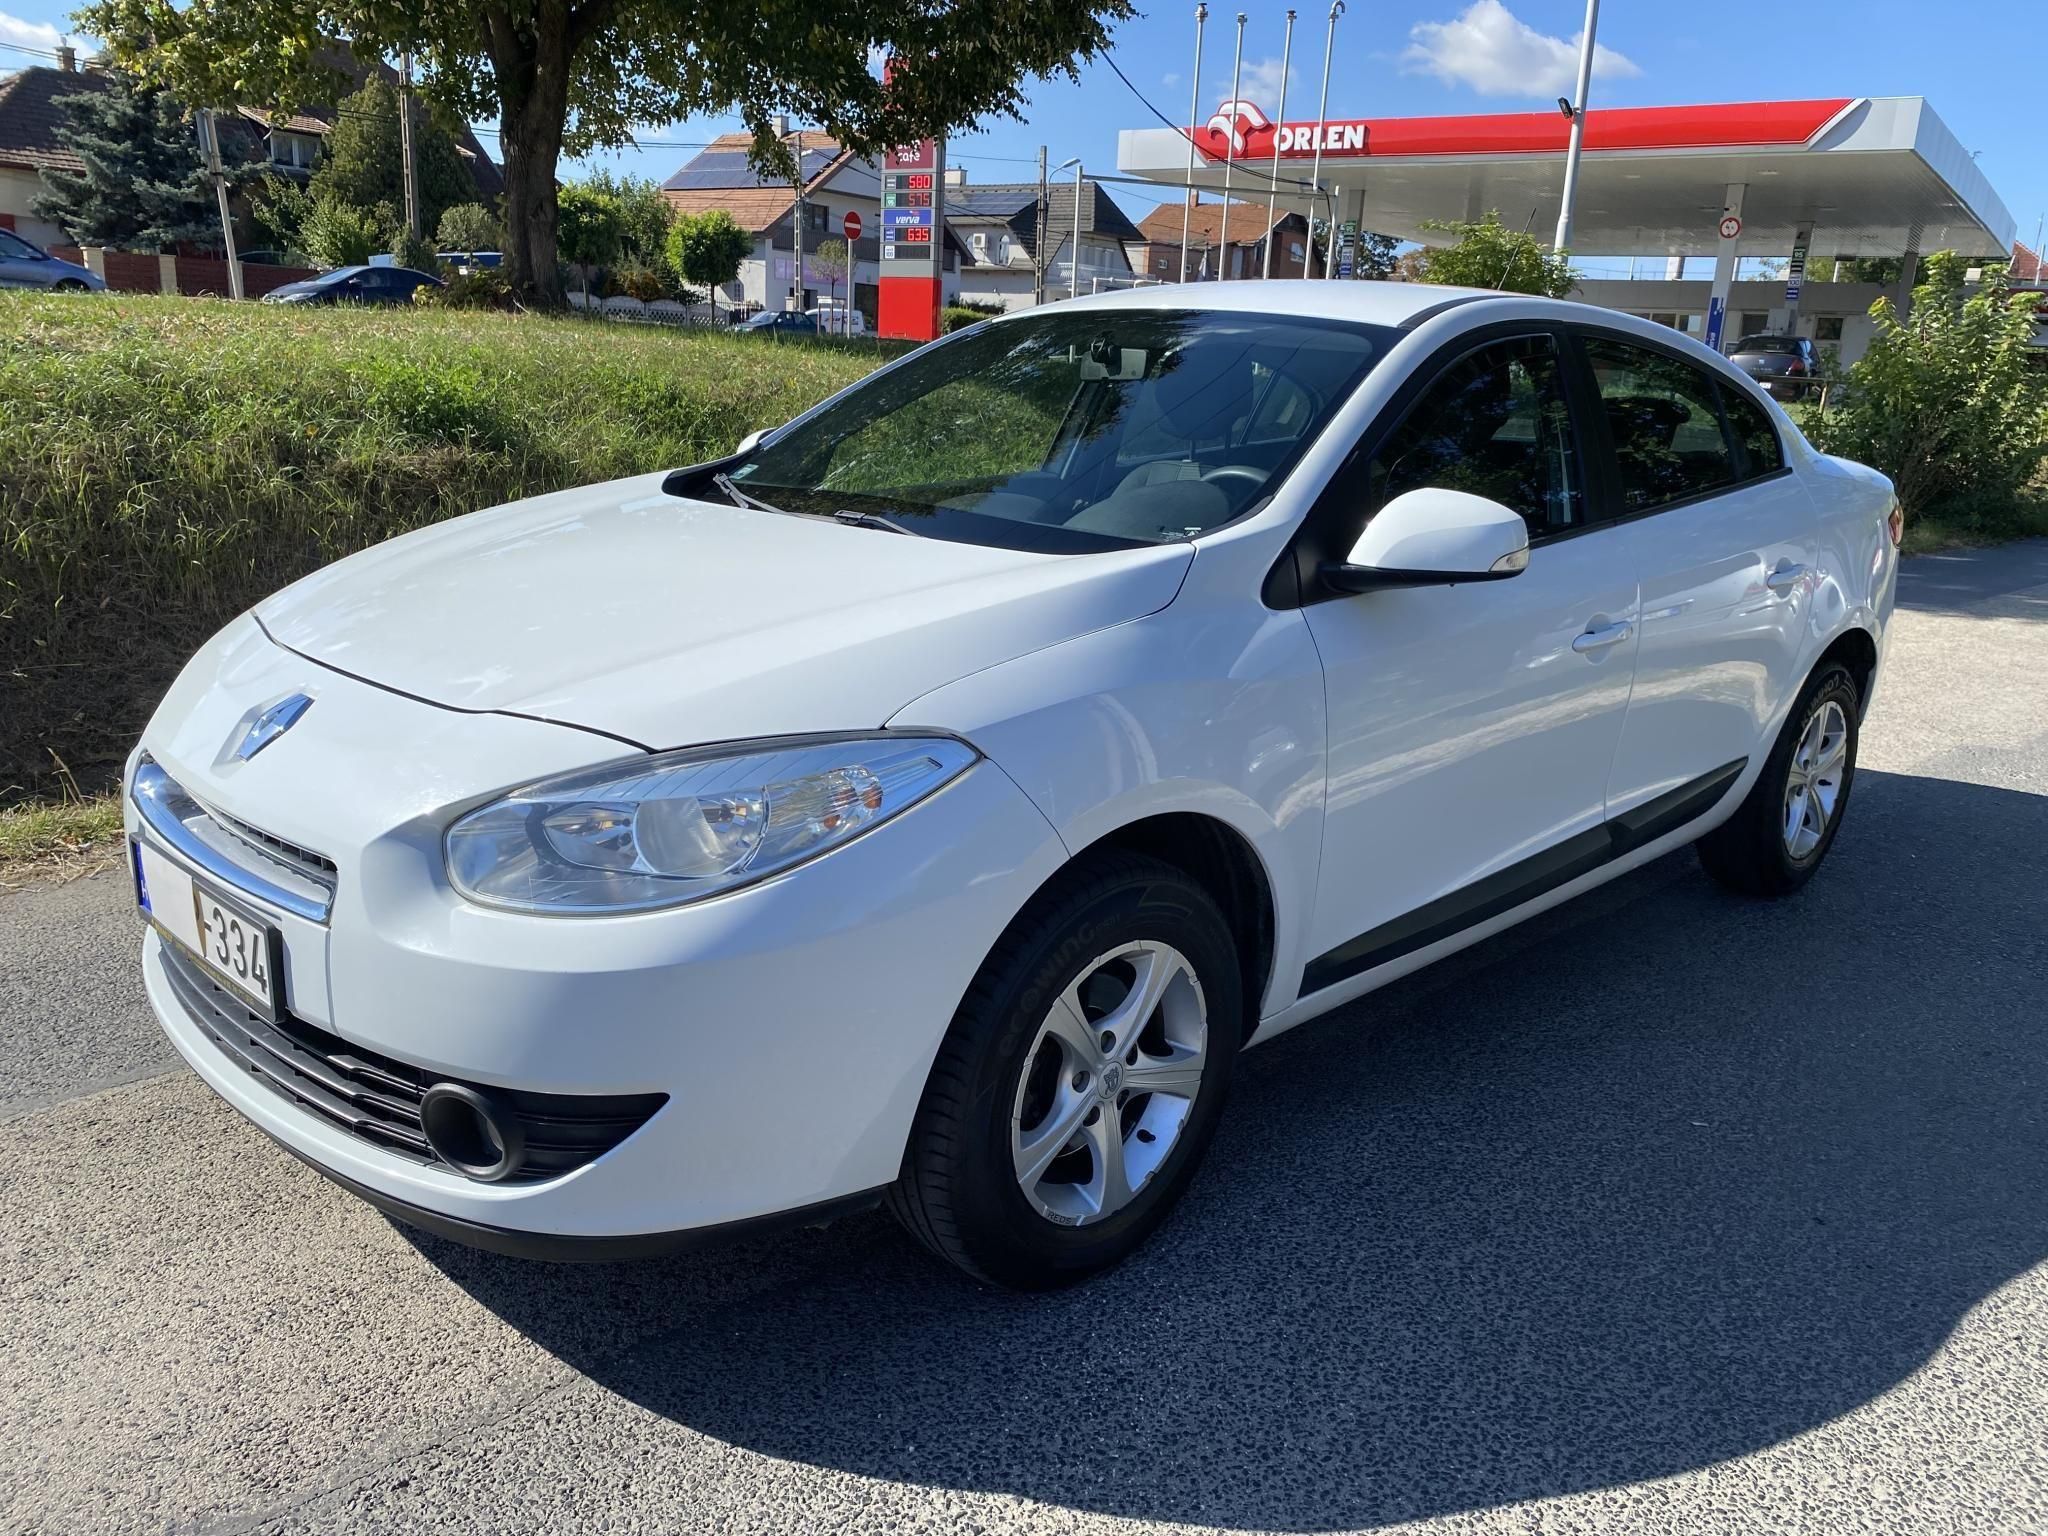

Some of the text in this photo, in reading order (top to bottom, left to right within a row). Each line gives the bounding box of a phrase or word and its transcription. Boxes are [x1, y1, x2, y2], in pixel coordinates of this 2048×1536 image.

[1273, 125, 1365, 151] ORLEN
[909, 175, 931, 189] 580
[909, 193, 930, 206] 575
[895, 216, 920, 224] verva
[907, 228, 929, 241] 635
